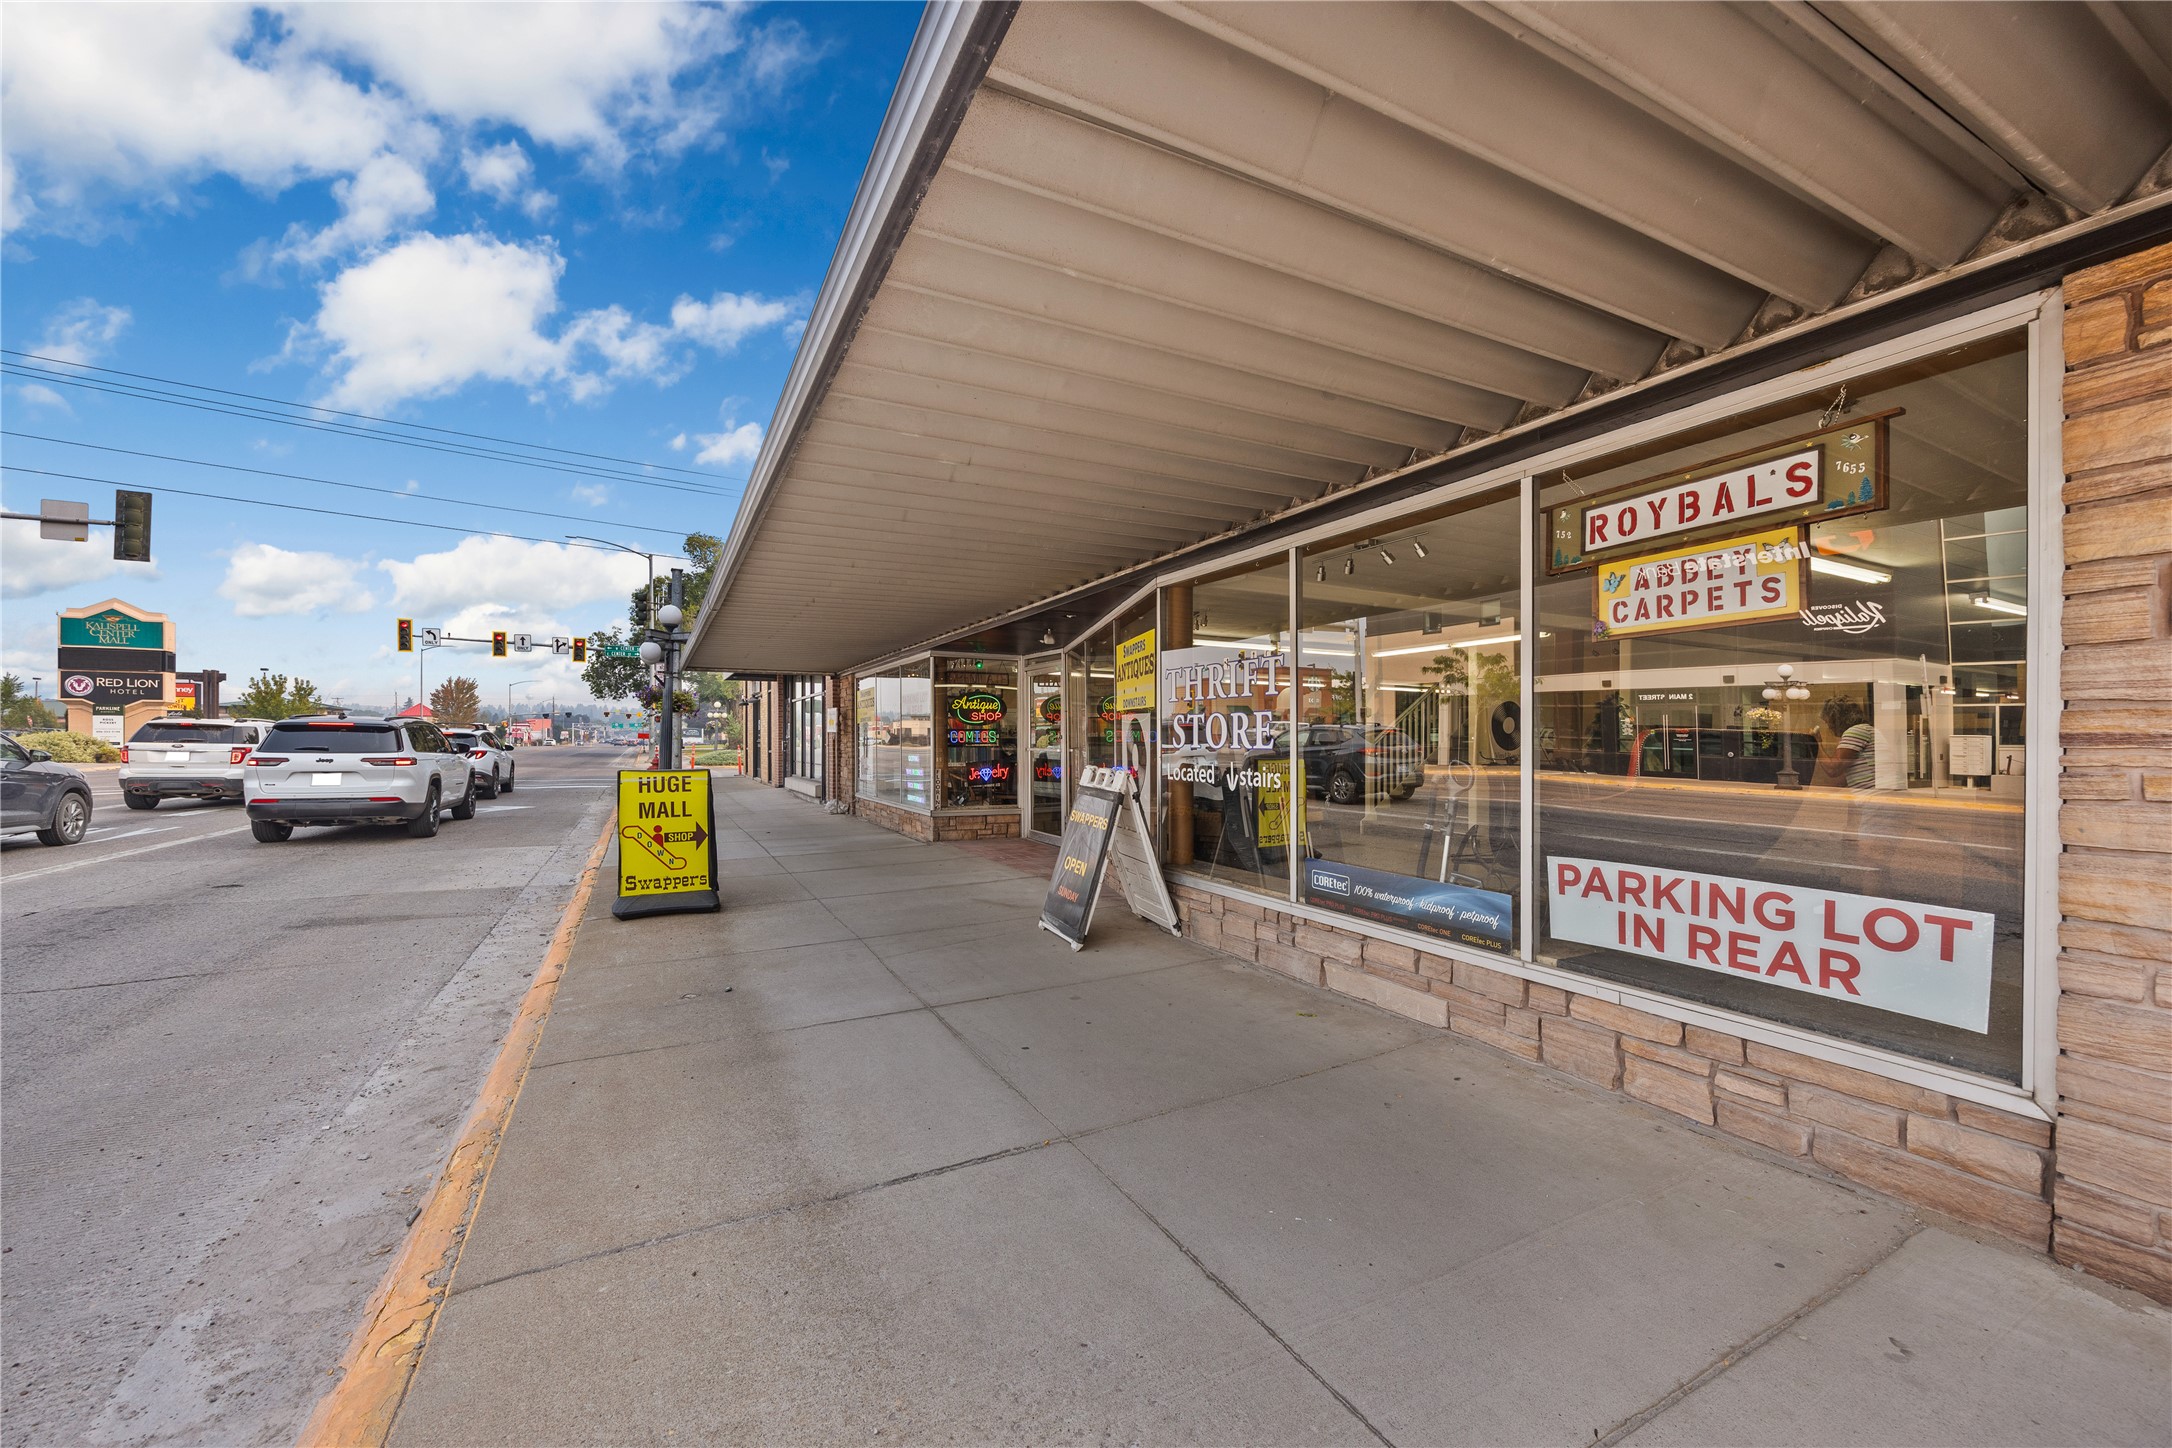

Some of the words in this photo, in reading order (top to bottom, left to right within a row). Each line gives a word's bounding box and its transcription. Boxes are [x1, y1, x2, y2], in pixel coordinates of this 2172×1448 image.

[1835, 461, 1866, 475] 7655
[1588, 461, 1814, 545] ROYBAL'S
[1556, 530, 1572, 540] 752
[1634, 548, 1752, 592] ABBEY
[1612, 576, 1782, 624] CARPETS
[85, 621, 140, 632] KALISPELL
[89, 629, 136, 638] CENTER
[98, 636, 130, 645] MALL
[1123, 639, 1146, 659] SWAPPERS
[1117, 652, 1155, 682] ANTIQUES
[96, 677, 123, 687] RED
[127, 678, 159, 688] LION
[1165, 653, 1285, 703] THRIFT
[952, 696, 999, 714] Antique
[1123, 696, 1147, 709] DOWNSTAIRS
[971, 711, 1002, 721] SHOP
[950, 730, 997, 744] COMICS
[1172, 711, 1275, 751] STORE
[1167, 763, 1215, 785] Located
[638, 775, 692, 794] HUGE
[638, 801, 693, 819] MALL
[1070, 809, 1109, 831] SWAPPERS
[668, 832, 694, 842] SHOP
[1064, 855, 1088, 877] OPEN
[625, 874, 708, 892] Swappers
[1313, 874, 1348, 892] COREtec
[1057, 884, 1080, 903] SUNDAY
[1353, 884, 1374, 898] 100%
[1374, 891, 1415, 911] waterproof
[1419, 898, 1454, 920] kidproof
[1459, 911, 1500, 930] petproof
[1556, 863, 1796, 933] PARKING
[1824, 899, 1973, 963] LOT
[1417, 923, 1439, 934] COREtec
[1438, 928, 1452, 937] ONE
[1461, 933, 1486, 947] COREtec
[1486, 940, 1502, 950] PLUS
[1617, 911, 1666, 953] IN
[1688, 923, 1862, 997] REAR
